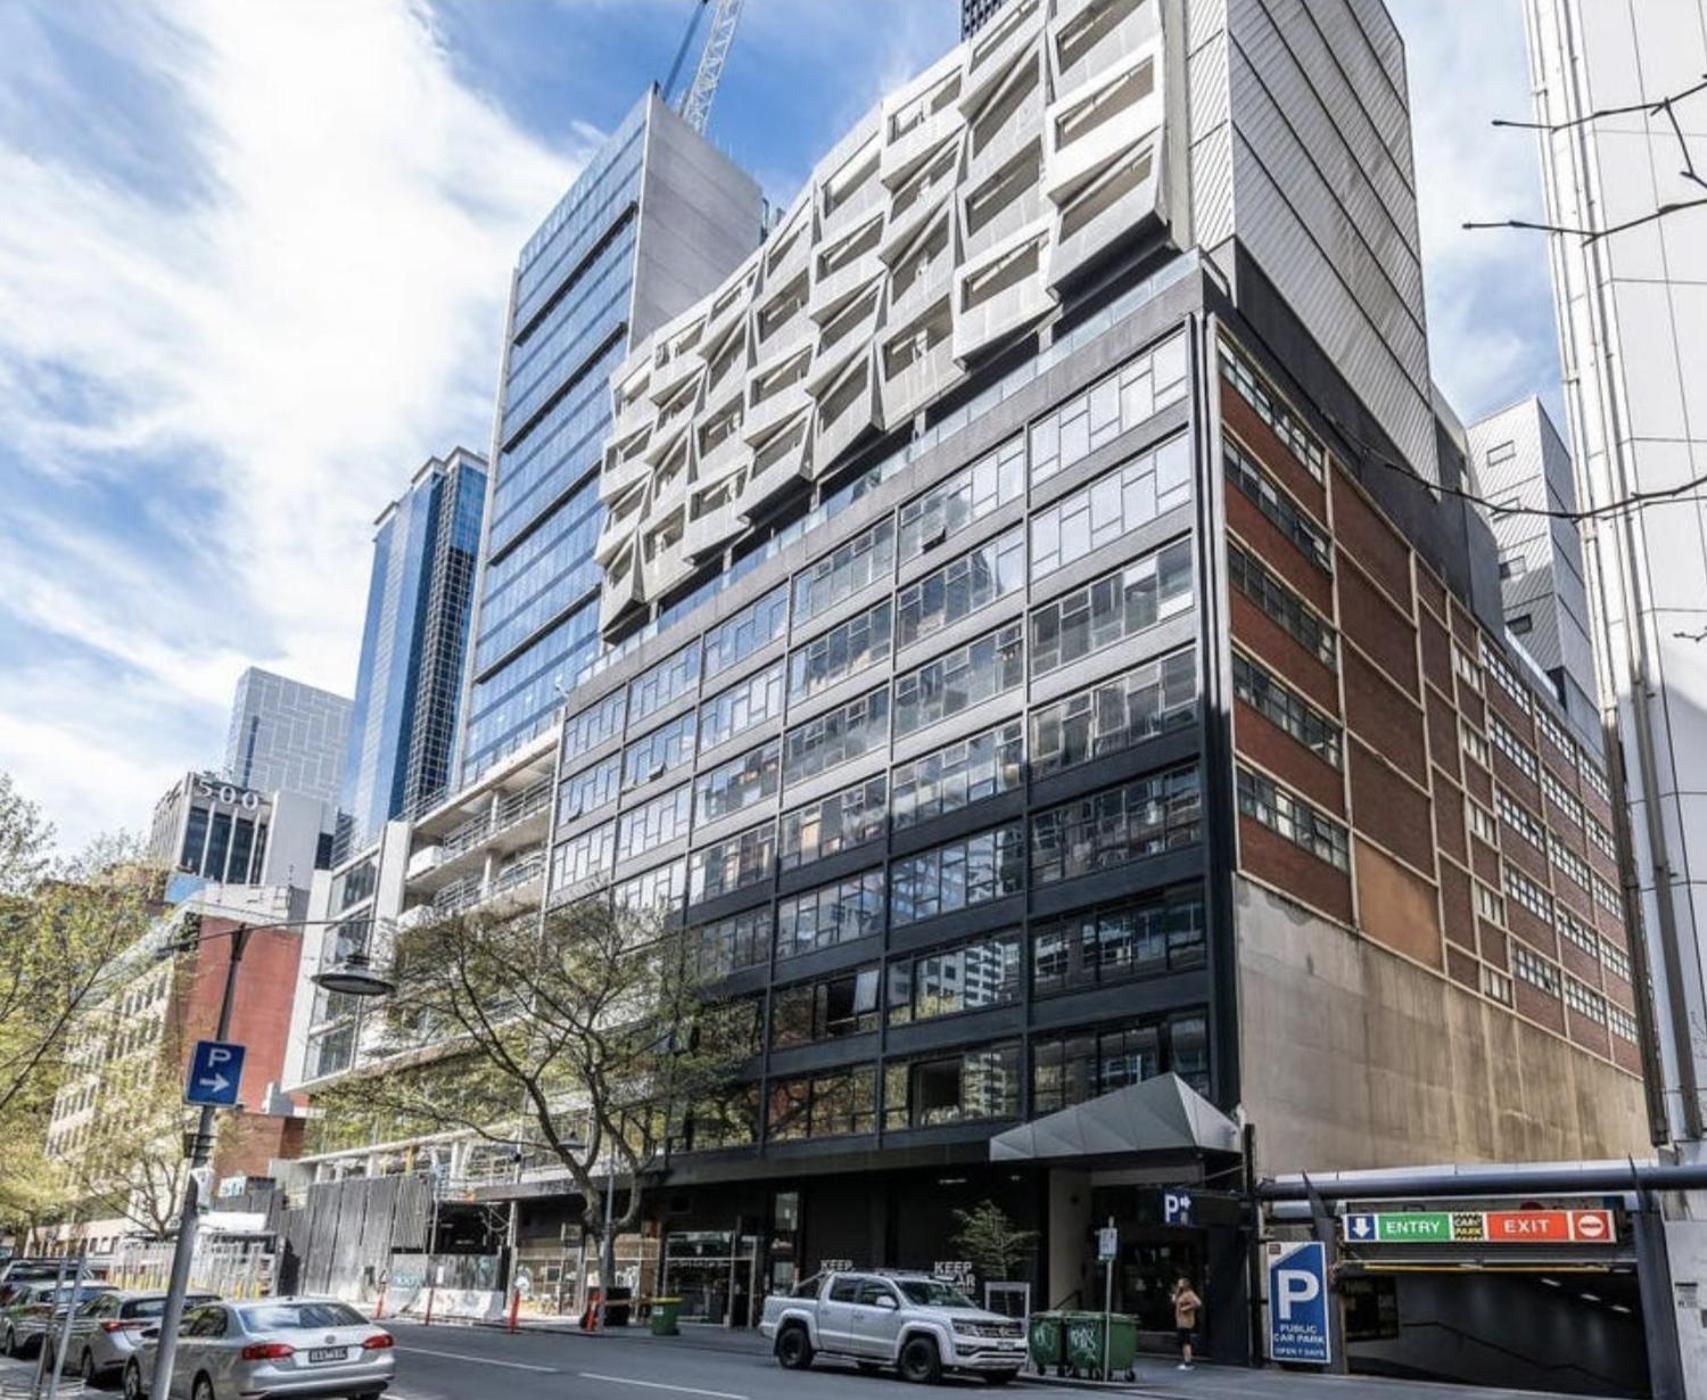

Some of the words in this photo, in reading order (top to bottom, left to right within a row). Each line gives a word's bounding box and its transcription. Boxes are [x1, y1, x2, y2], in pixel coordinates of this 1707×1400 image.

[199, 781, 259, 810] 500
[208, 1048, 231, 1068] P
[1164, 1194, 1180, 1223] P
[1386, 1221, 1440, 1233] ENTRY
[1503, 1219, 1549, 1233] EXIT
[934, 1260, 972, 1274] KEEP
[1278, 1269, 1319, 1319] P
[1280, 1323, 1317, 1334] PUBLIC
[1273, 1333, 1296, 1343] CAR
[1296, 1334, 1325, 1344] PARK
